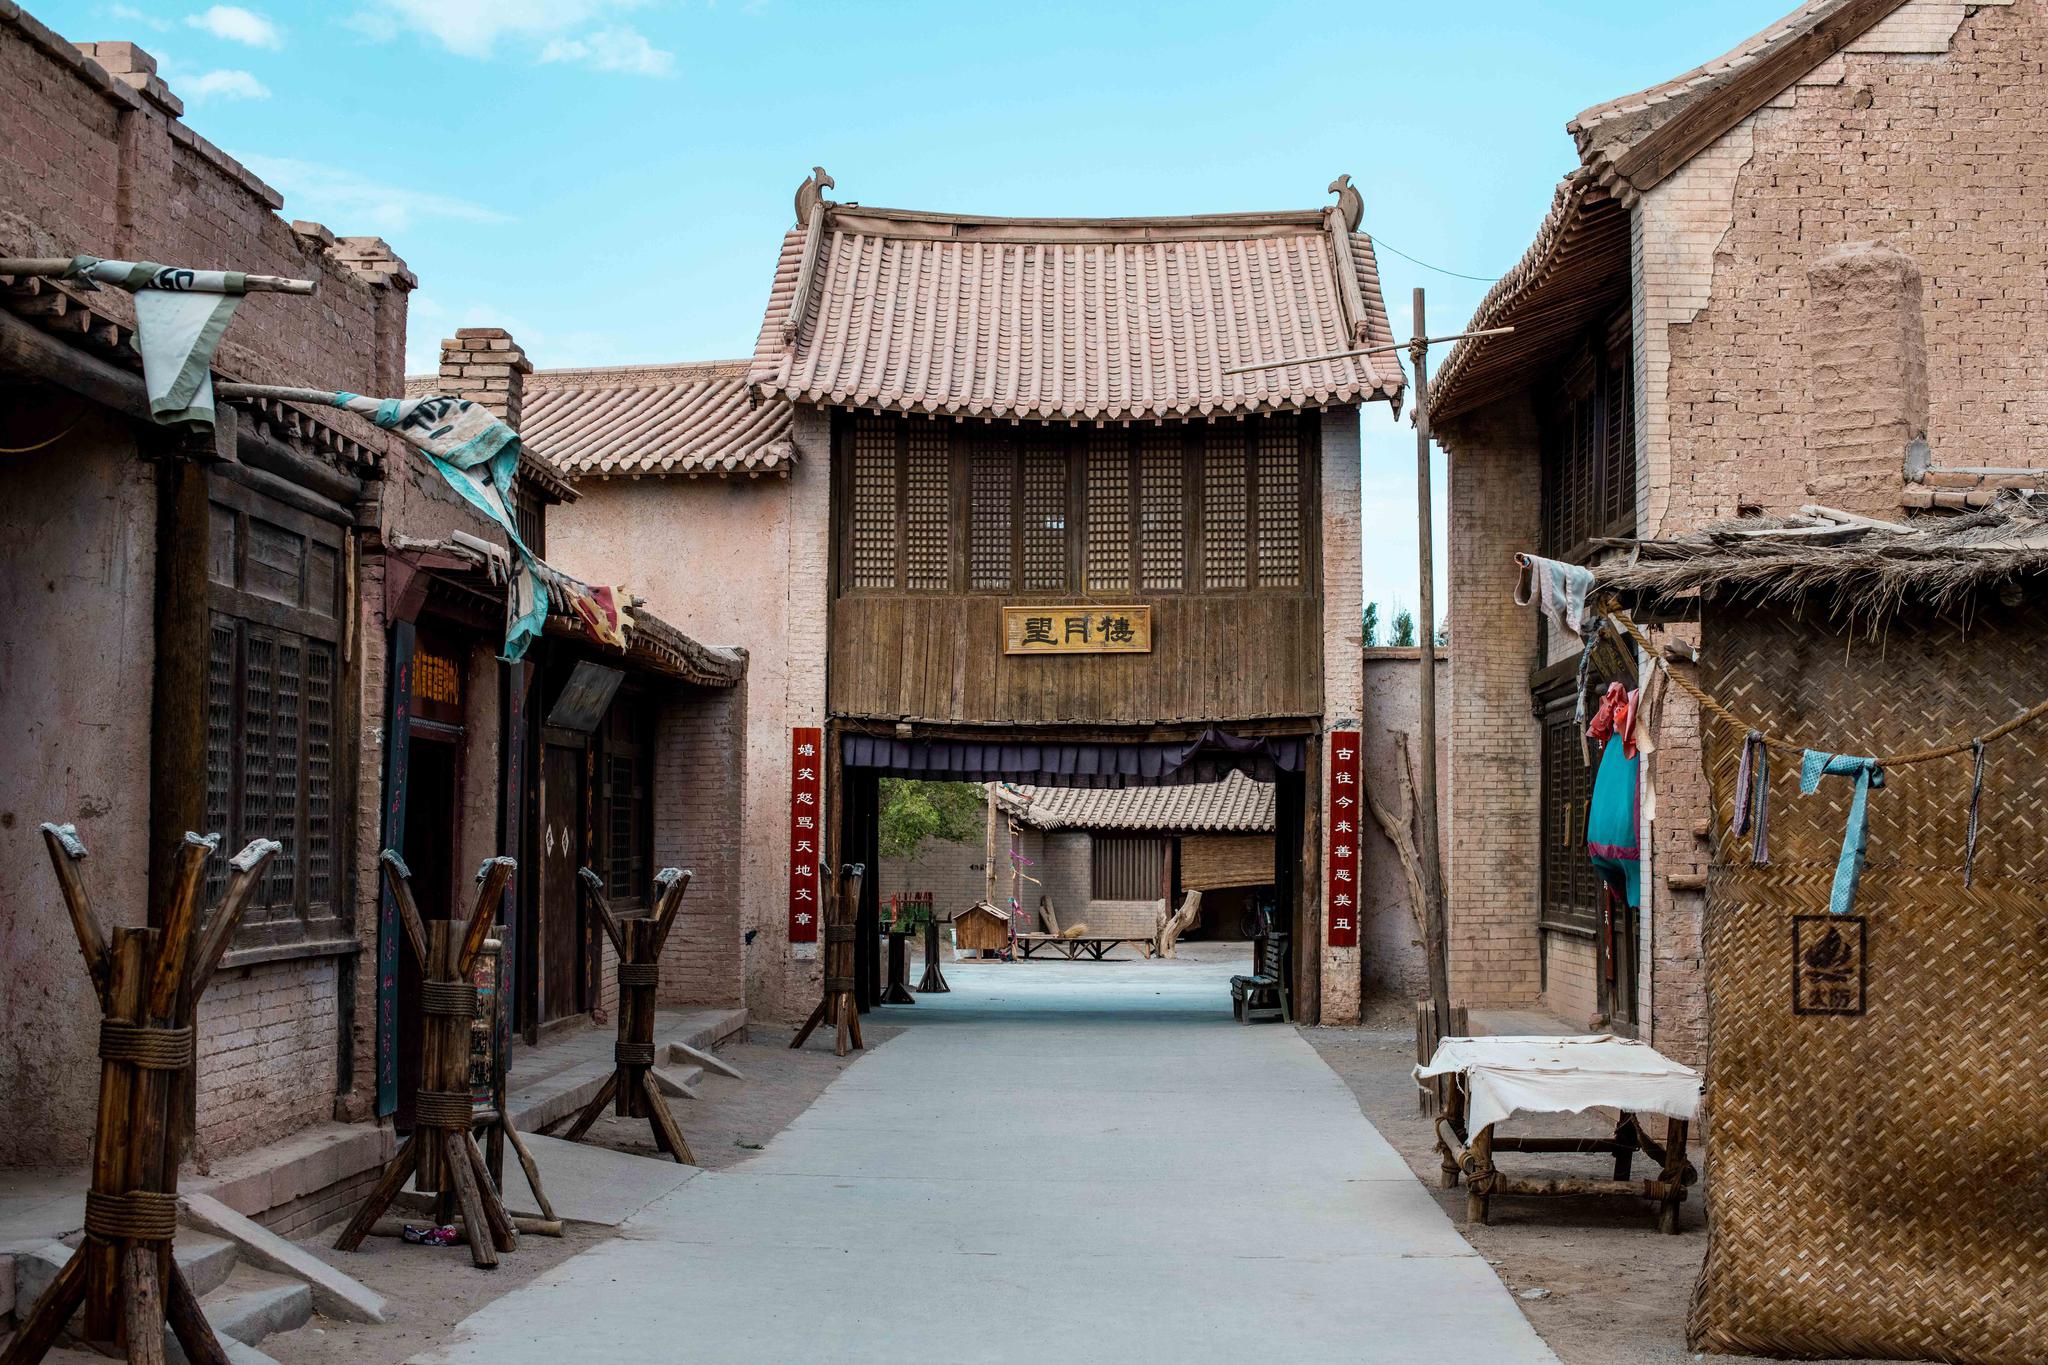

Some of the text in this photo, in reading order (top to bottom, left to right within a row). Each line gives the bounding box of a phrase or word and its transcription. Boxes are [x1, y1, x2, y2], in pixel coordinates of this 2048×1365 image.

[1333, 747, 1355, 931] 古往今来善恶美丑
